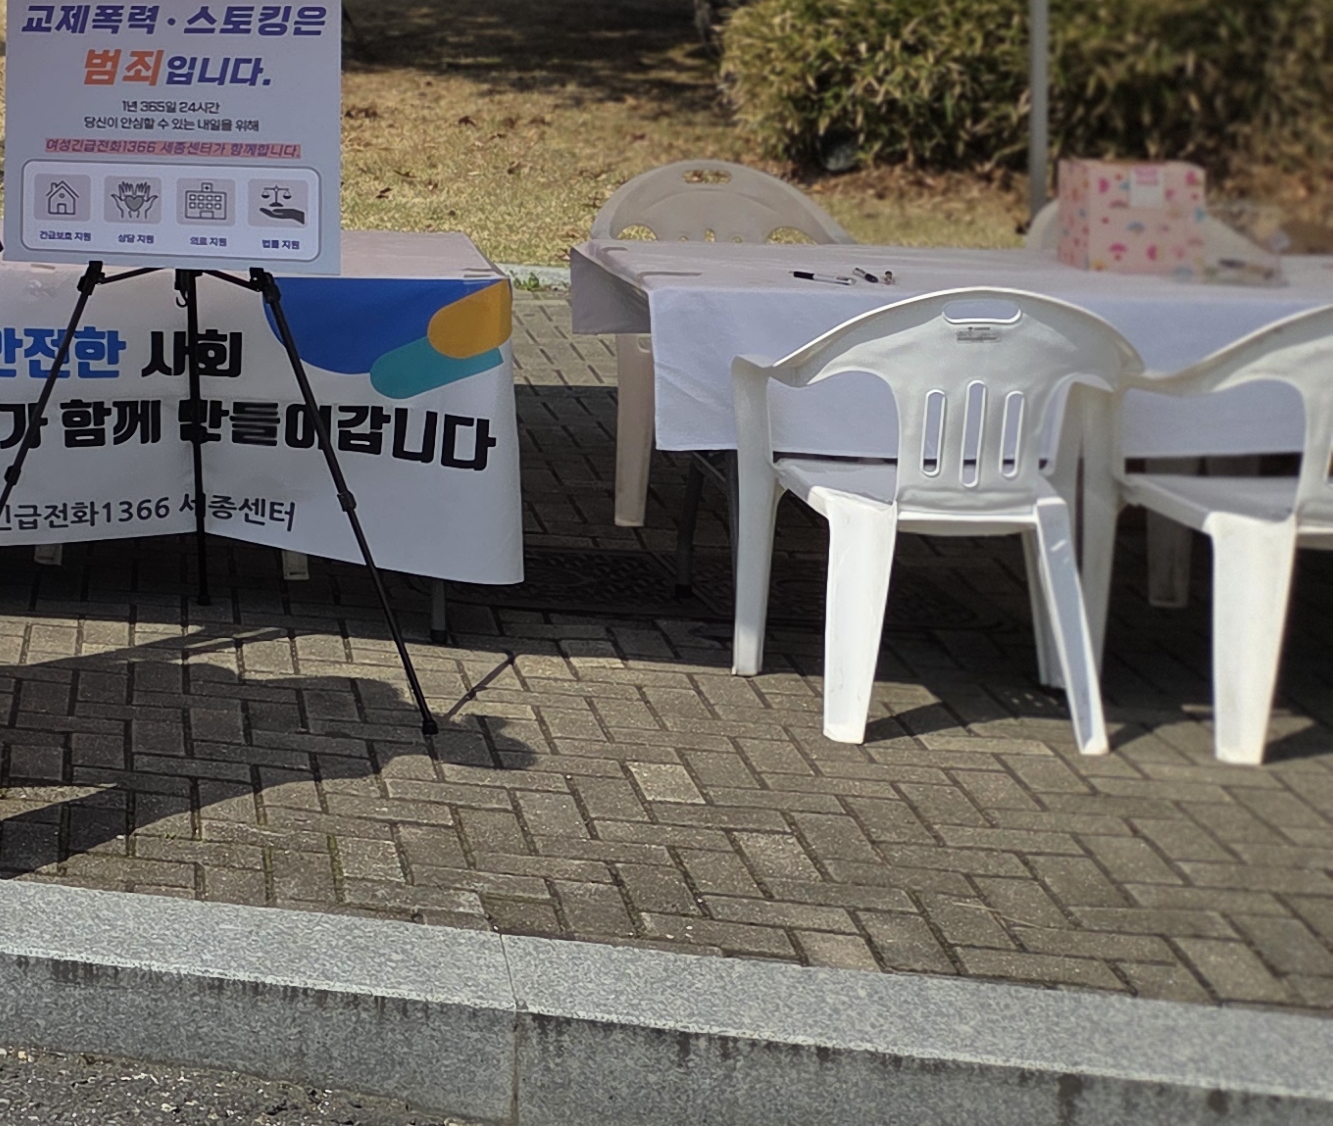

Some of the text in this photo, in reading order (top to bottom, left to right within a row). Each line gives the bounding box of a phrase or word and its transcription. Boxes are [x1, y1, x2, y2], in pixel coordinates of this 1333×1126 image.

[22, 5, 327, 37] 교제폭력 스토킹은
[84, 48, 272, 87] 범죄입니다.
[122, 100, 220, 114] 1년 365일 24시간
[84, 117, 259, 132] 당신이 안심할 수 있는 내일을 위해
[46, 139, 300, 157] 여성긴급전화1366 세종센터가 함께합니다.
[74, 232, 91, 242] 지원
[137, 234, 154, 244] 지원
[209, 236, 227, 247] 지원
[282, 240, 300, 250] 지원
[141, 328, 243, 378] 사회
[60, 399, 161, 448] 함께
[178, 399, 496, 471] 만들어갑니다
[179, 492, 295, 532] 세종센터
